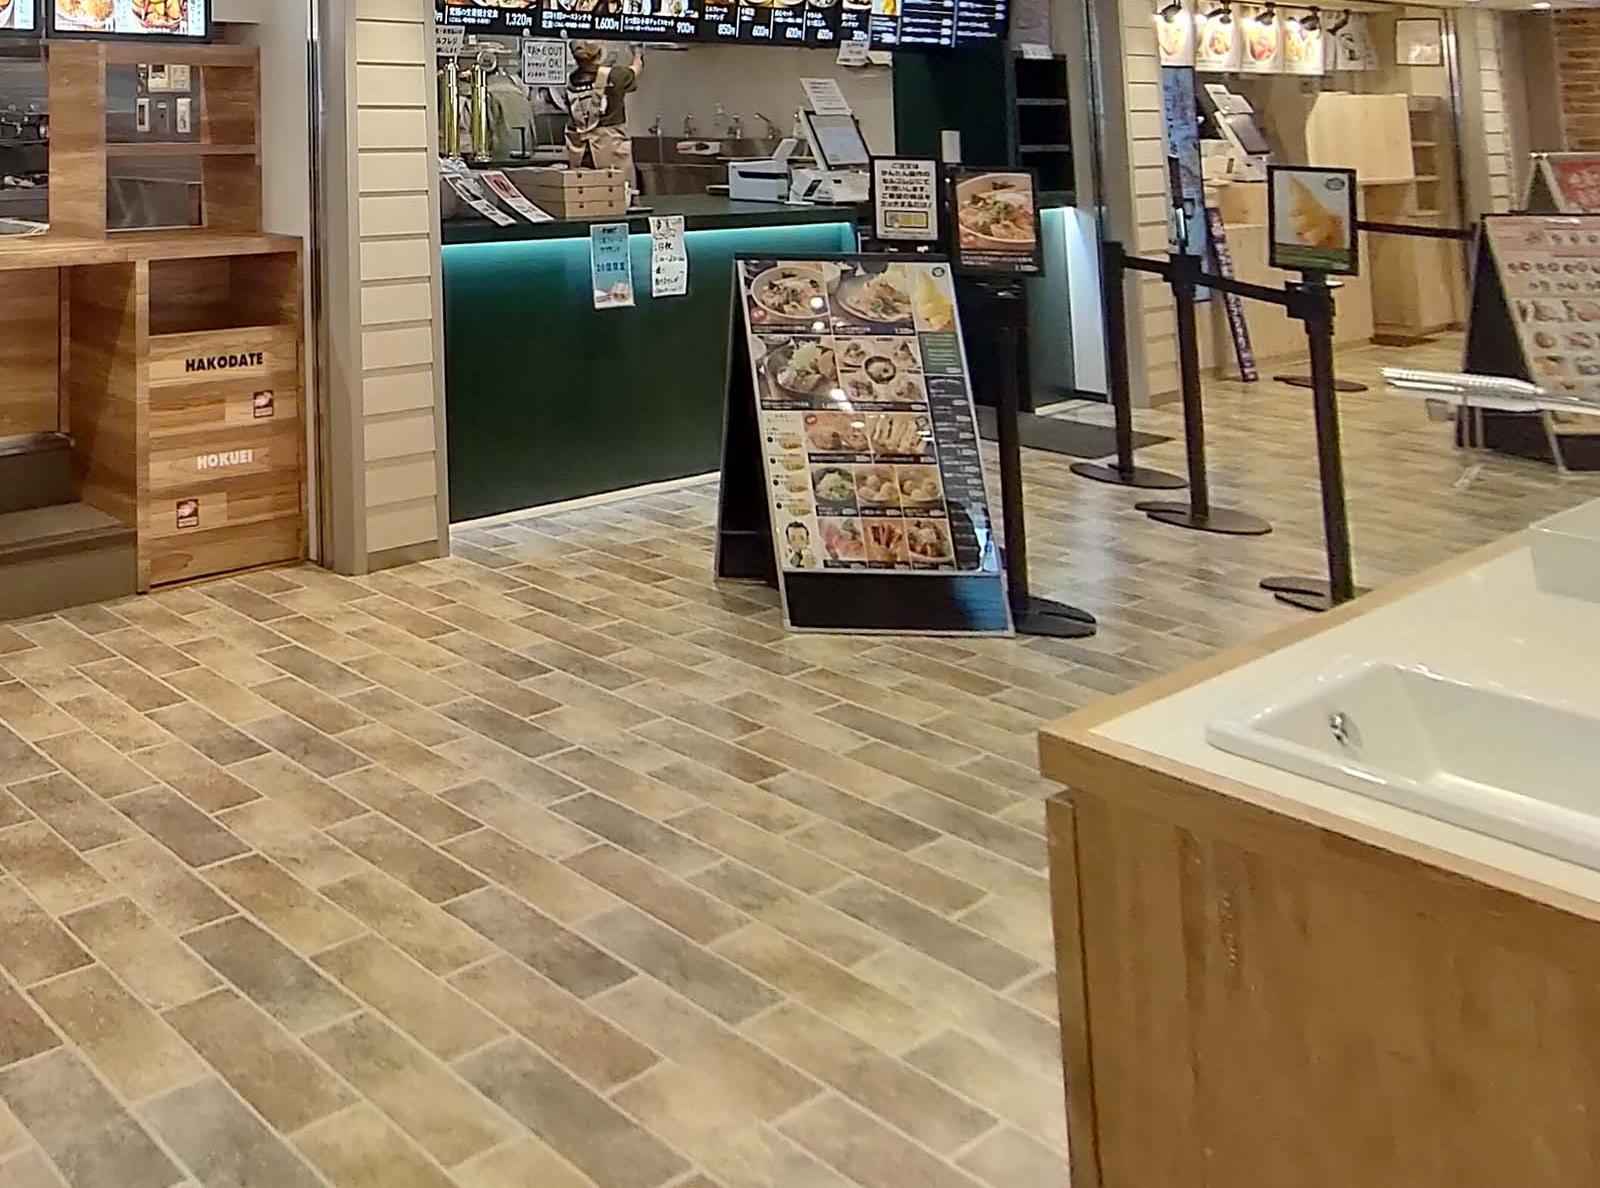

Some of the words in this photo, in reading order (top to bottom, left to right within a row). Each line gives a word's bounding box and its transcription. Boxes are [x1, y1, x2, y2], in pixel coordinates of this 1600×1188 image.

[527, 46, 547, 55] TAKE
[548, 46, 563, 56] OUT
[185, 352, 263, 372] HAKODATE
[197, 449, 253, 469] HOKUEI
